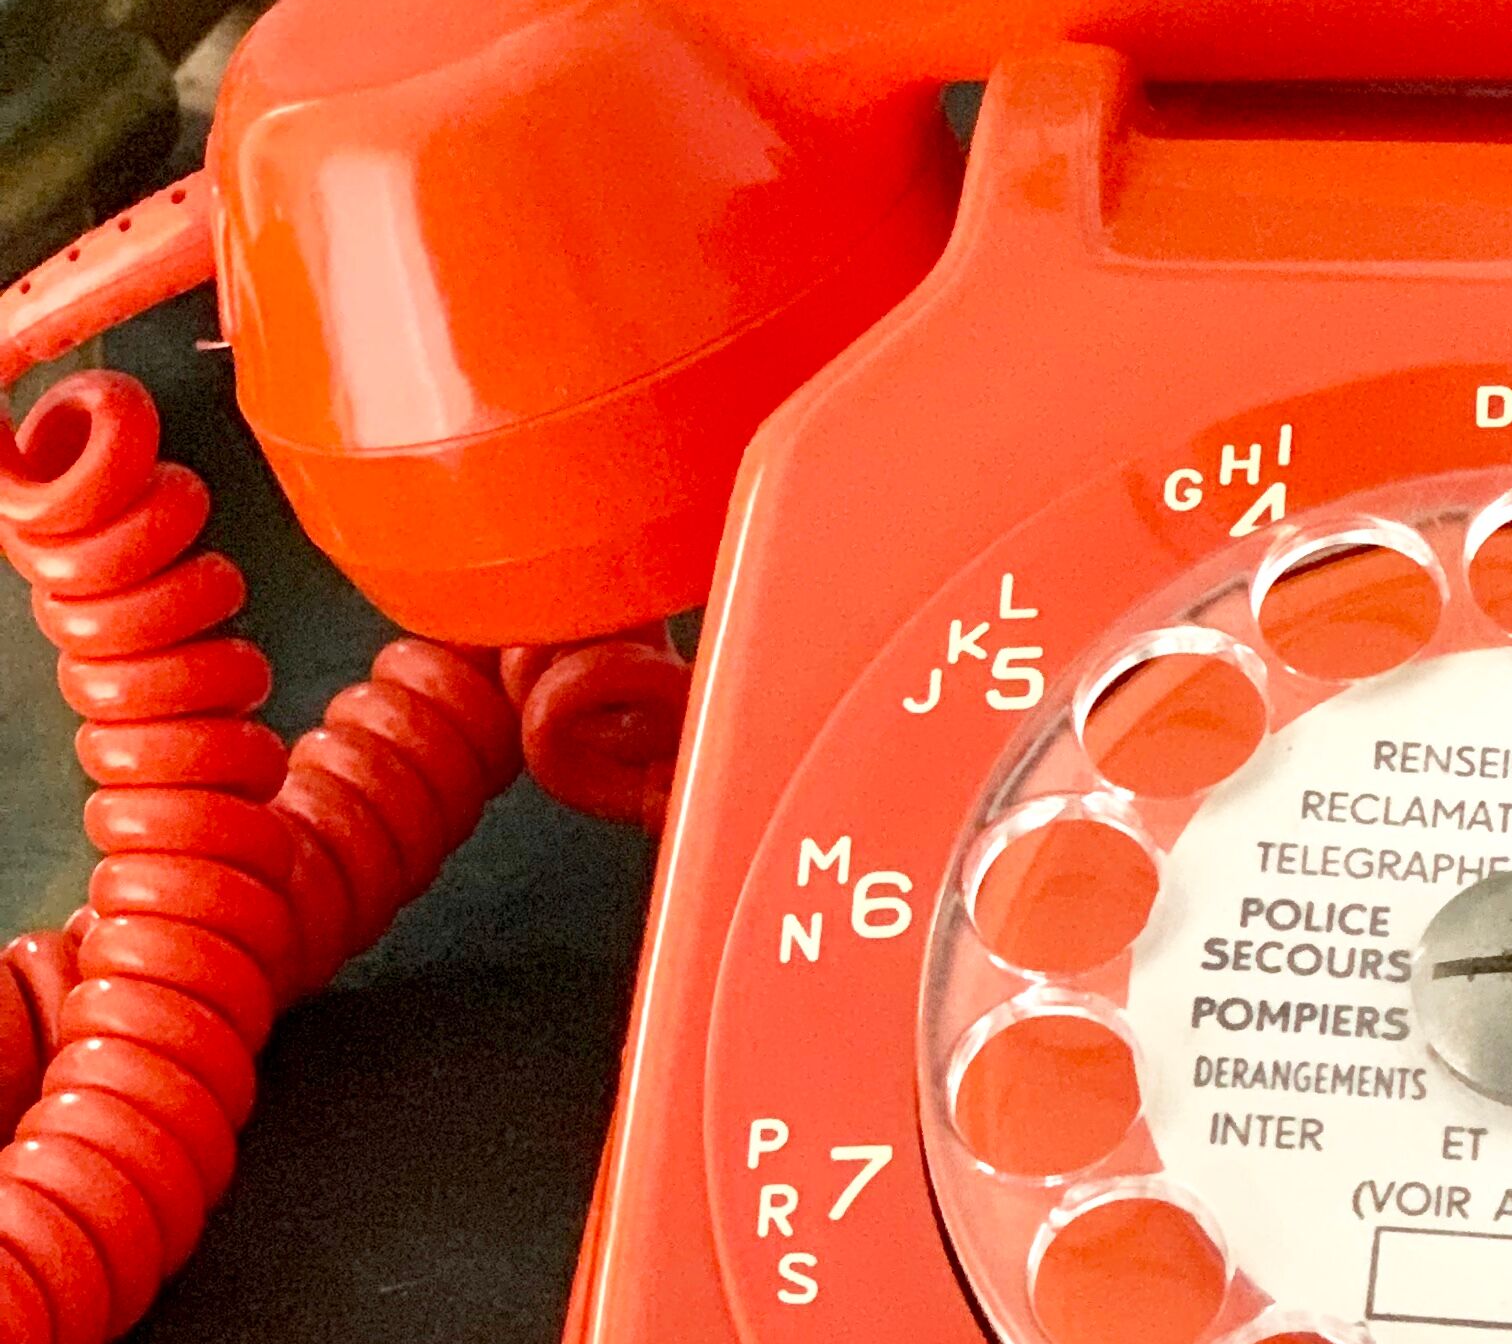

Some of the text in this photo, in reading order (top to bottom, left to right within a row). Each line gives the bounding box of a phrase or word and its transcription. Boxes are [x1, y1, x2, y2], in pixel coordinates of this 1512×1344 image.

[1163, 424, 1292, 517] GHI
[985, 646, 1044, 710] 5
[851, 870, 913, 939] 6
[1240, 897, 1391, 937] POLICE
[1201, 939, 1412, 983] SECOURS
[1191, 997, 1410, 1042] POMPIERS
[1192, 1056, 1427, 1100] DERANGEMENTS
[1208, 1114, 1325, 1151] INTER
[1442, 1127, 1488, 1161] ET
[830, 1145, 893, 1220] 7
[1352, 1180, 1472, 1220] (VOIR
